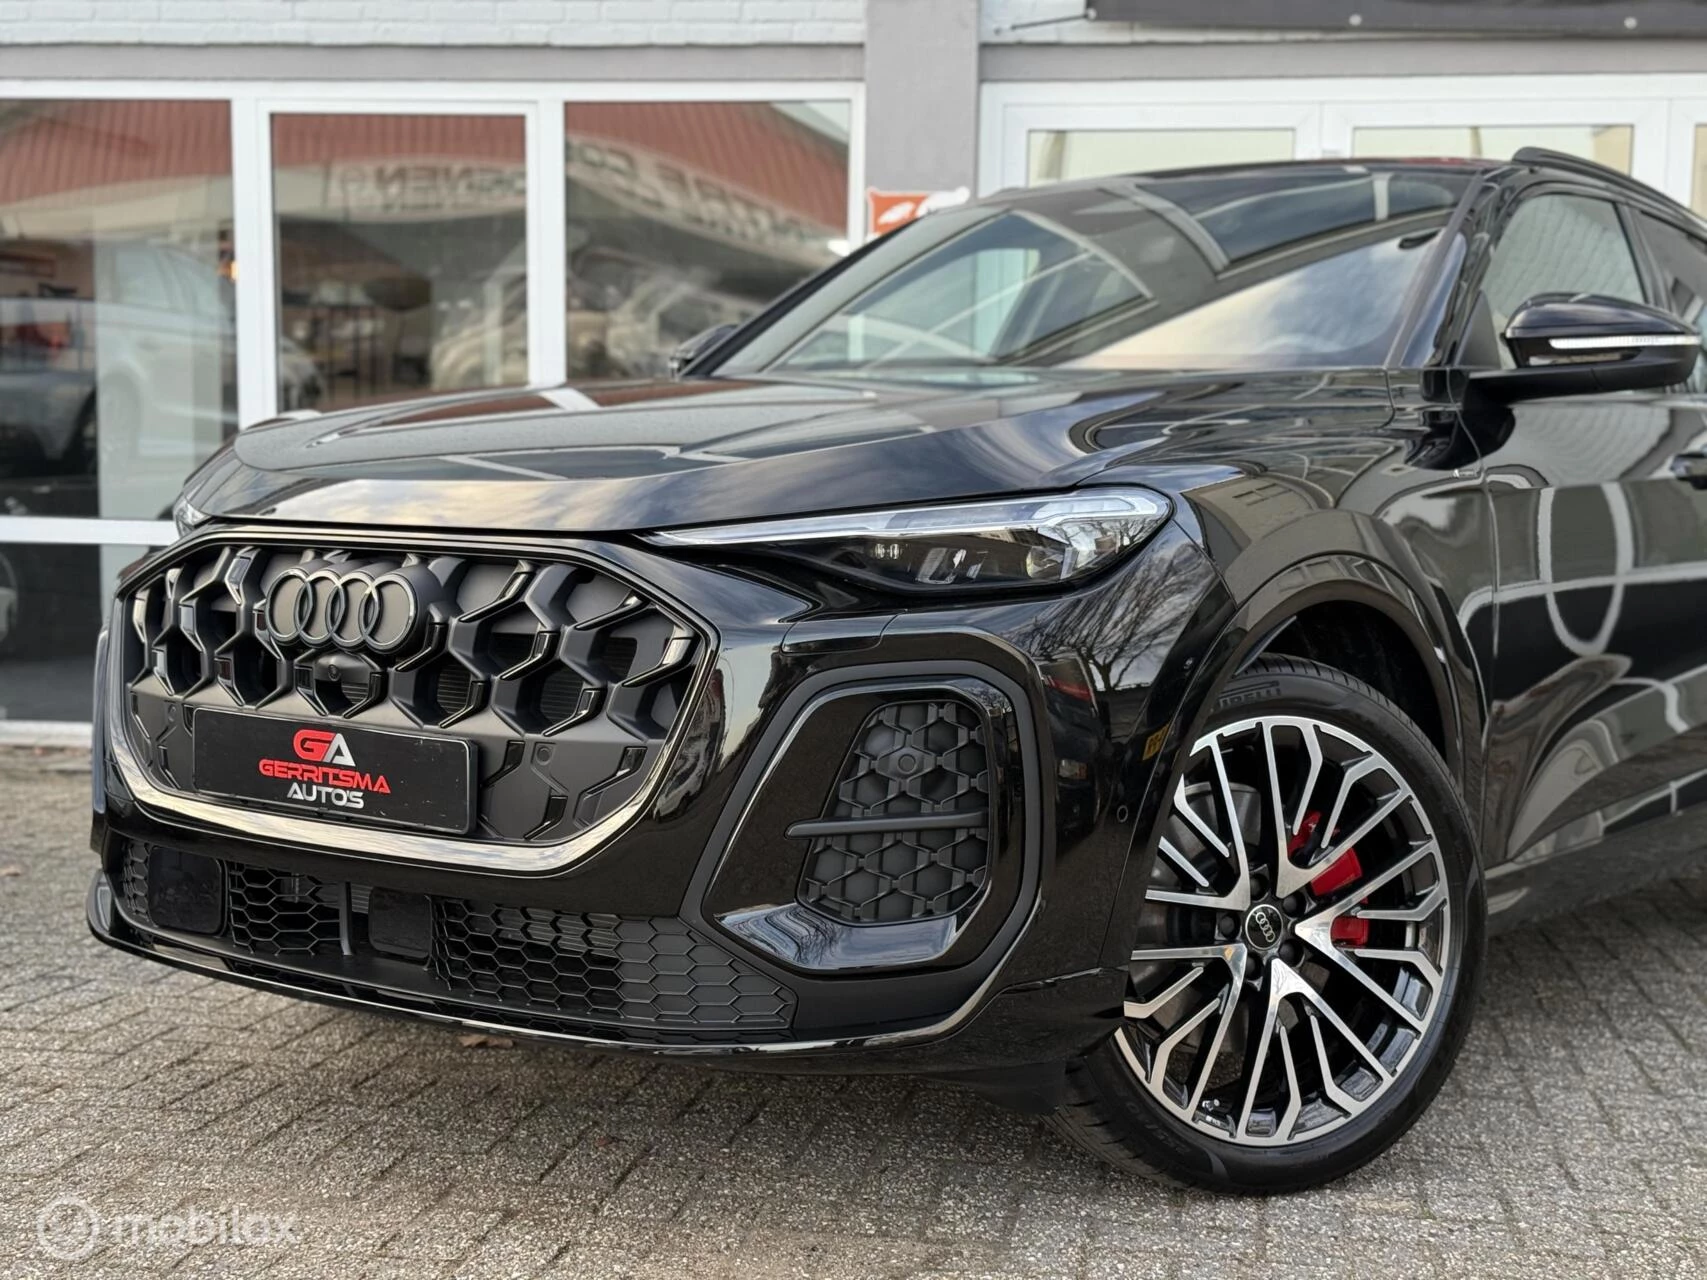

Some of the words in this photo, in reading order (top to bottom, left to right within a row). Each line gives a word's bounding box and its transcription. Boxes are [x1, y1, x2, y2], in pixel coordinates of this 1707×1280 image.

[293, 729, 356, 767] GA
[259, 759, 391, 793] GERRITSMA
[287, 782, 364, 809] AUTO'S
